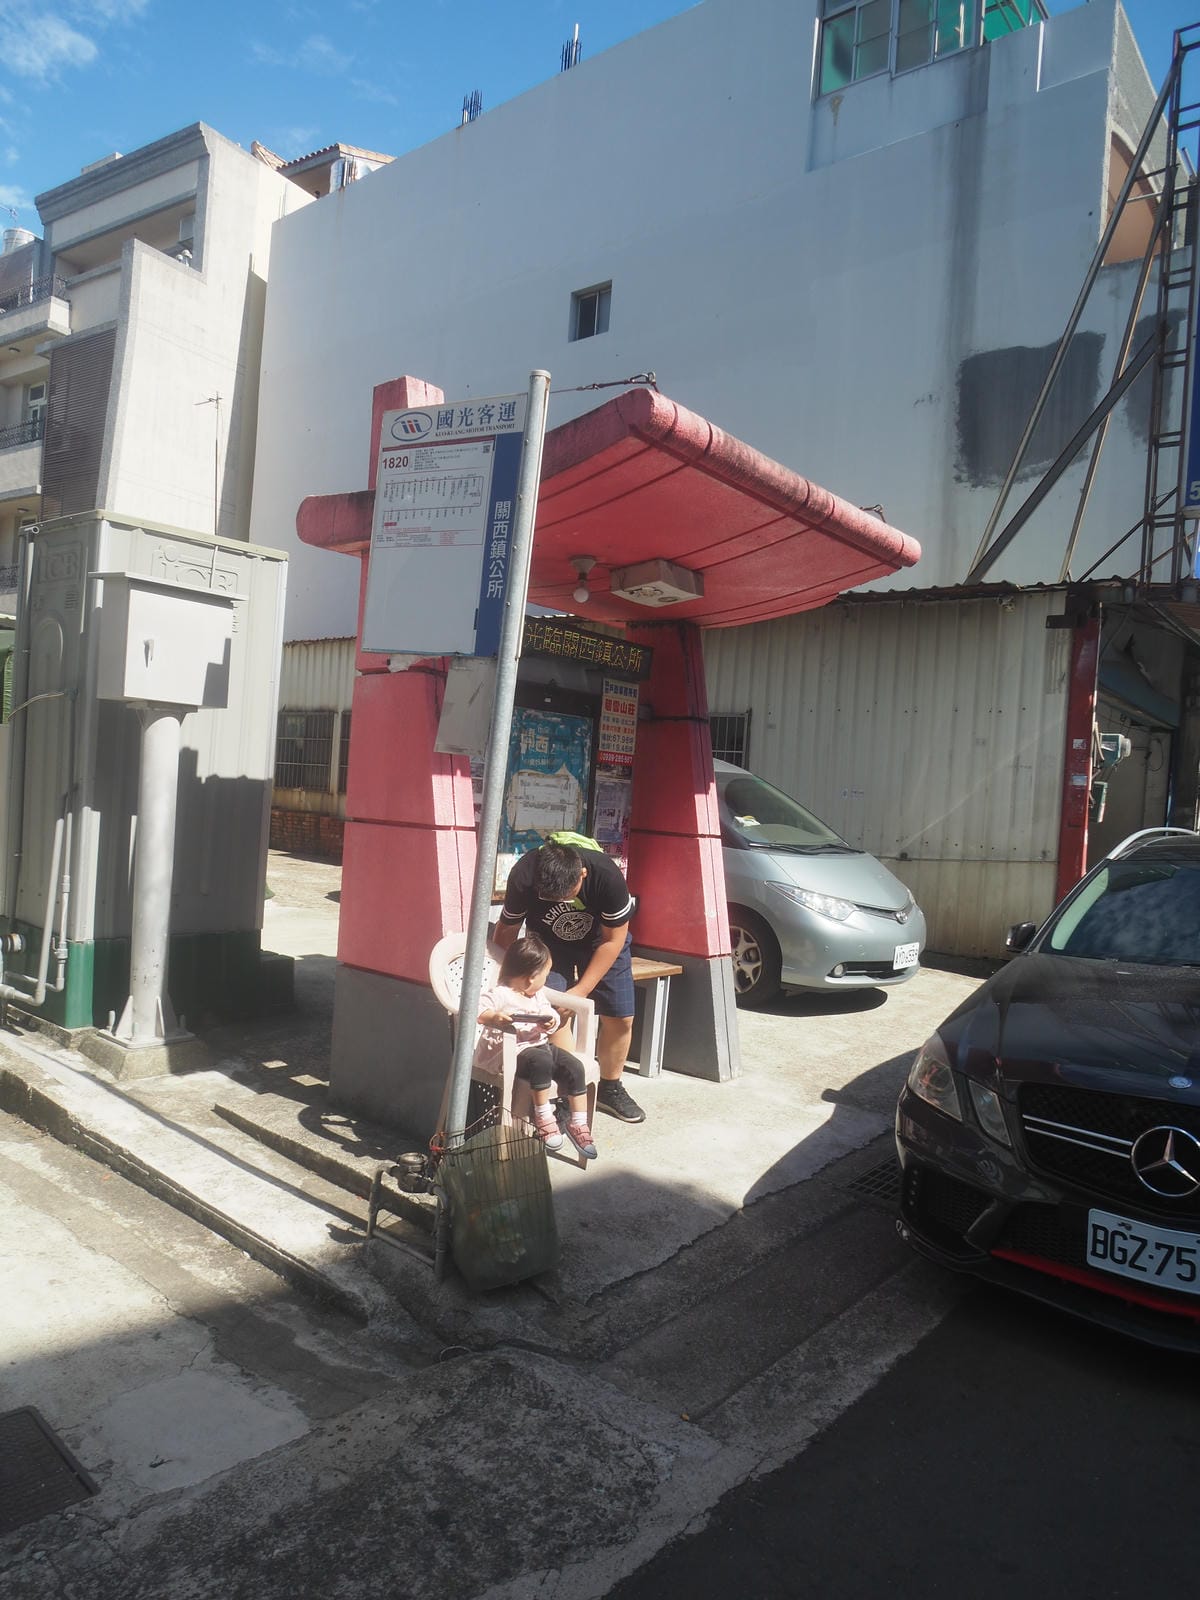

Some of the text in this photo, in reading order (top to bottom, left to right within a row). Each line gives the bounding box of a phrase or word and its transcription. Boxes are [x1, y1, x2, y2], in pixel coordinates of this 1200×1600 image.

[436, 402, 516, 430] 國光客運
[382, 456, 409, 469] 1820
[486, 500, 512, 599] 關西鎮公所
